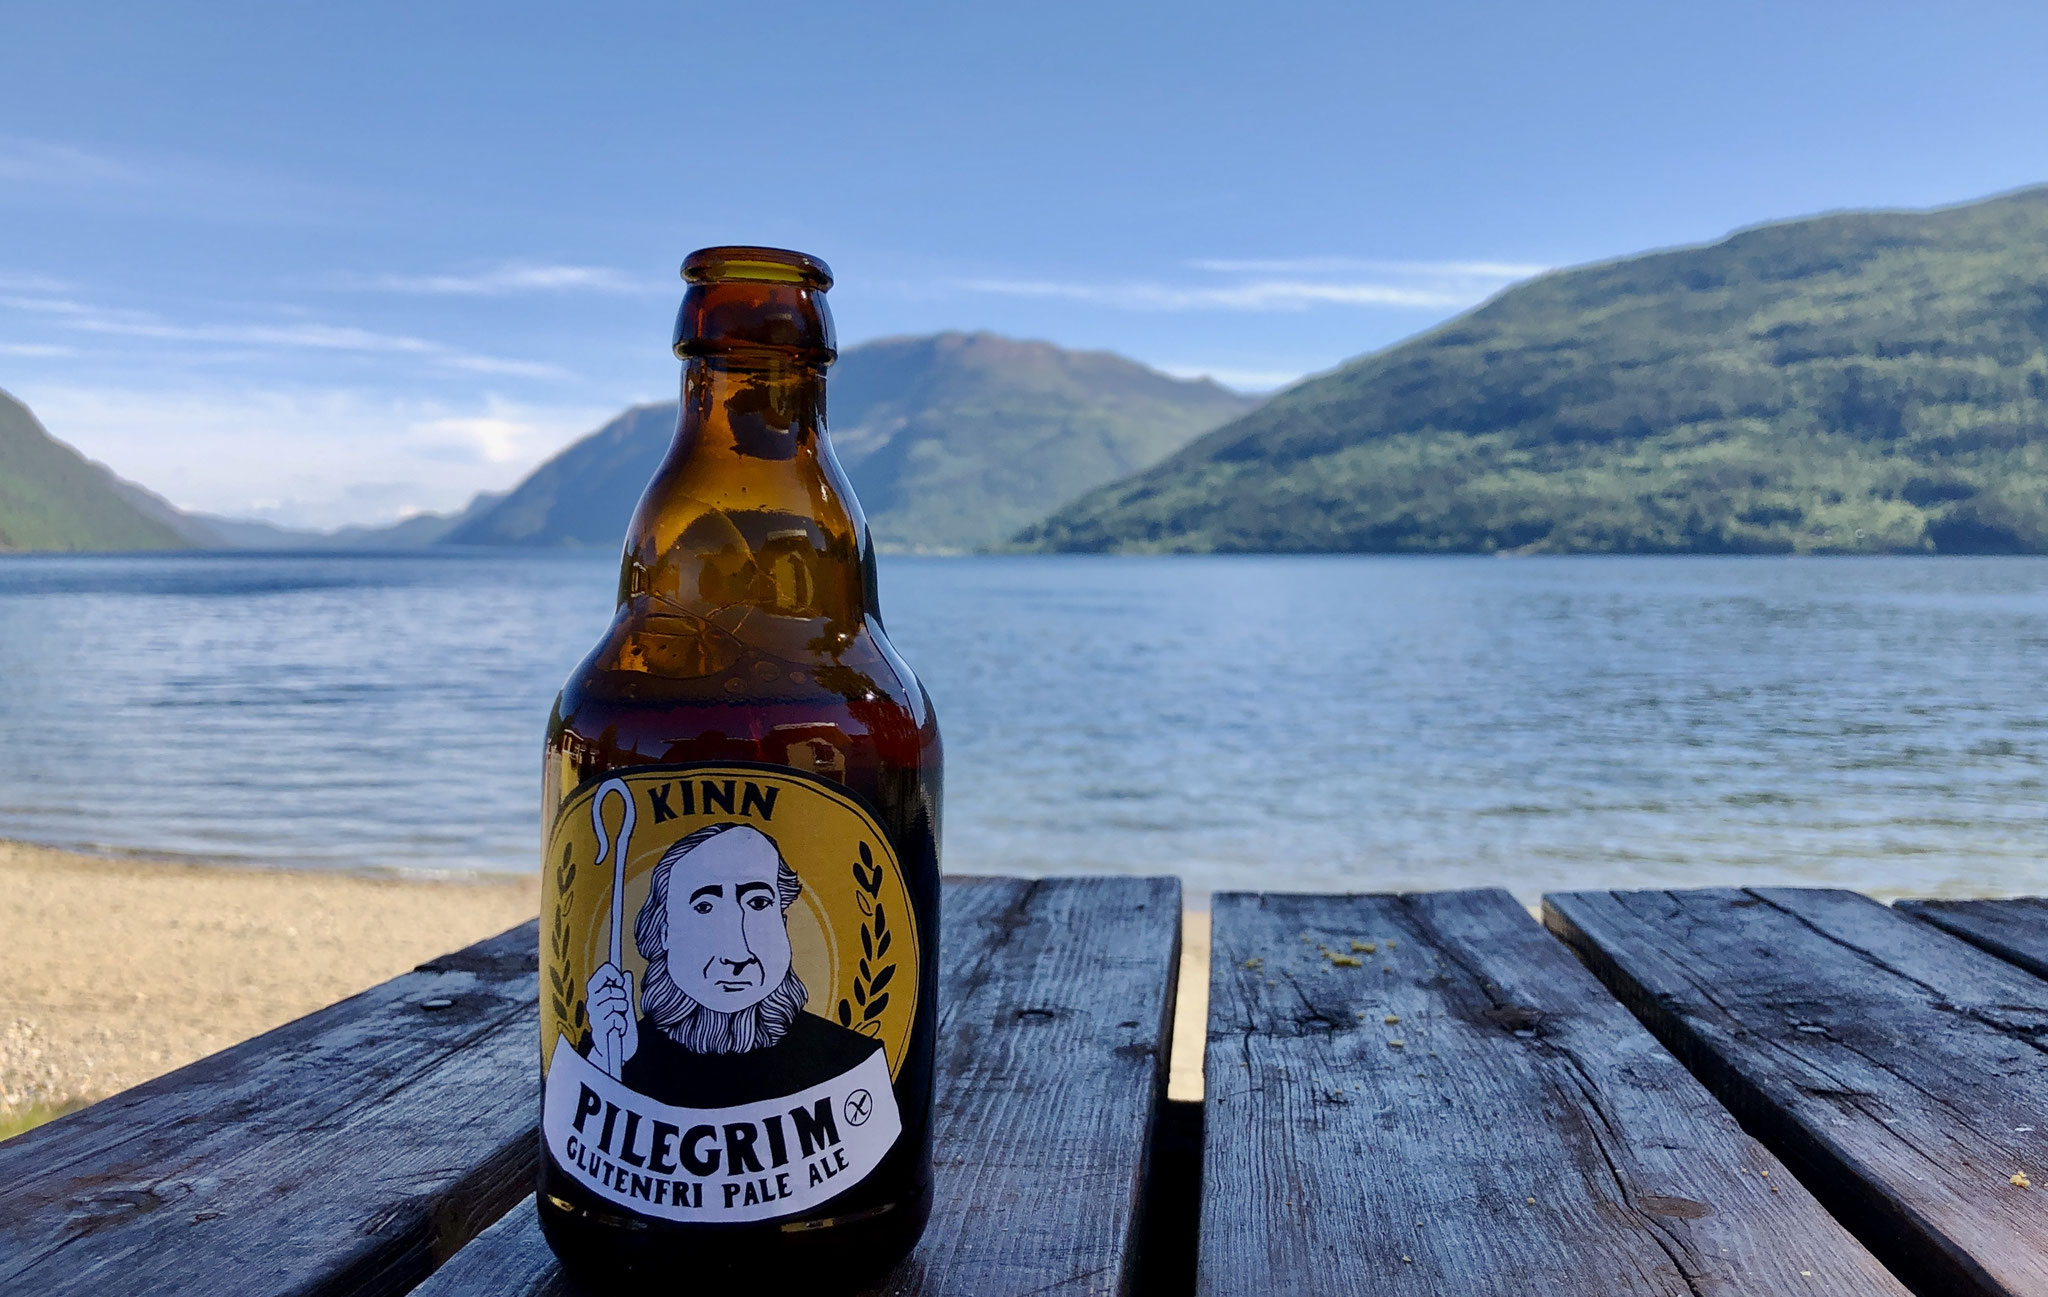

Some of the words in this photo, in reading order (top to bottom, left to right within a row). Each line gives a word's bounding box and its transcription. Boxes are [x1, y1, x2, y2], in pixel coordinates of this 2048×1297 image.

[648, 780, 780, 824] KINN
[573, 1082, 841, 1177] PILEGRIM
[566, 1137, 703, 1208] GLUTENFRI
[722, 1173, 793, 1208] PALE
[808, 1147, 850, 1188] ALE
